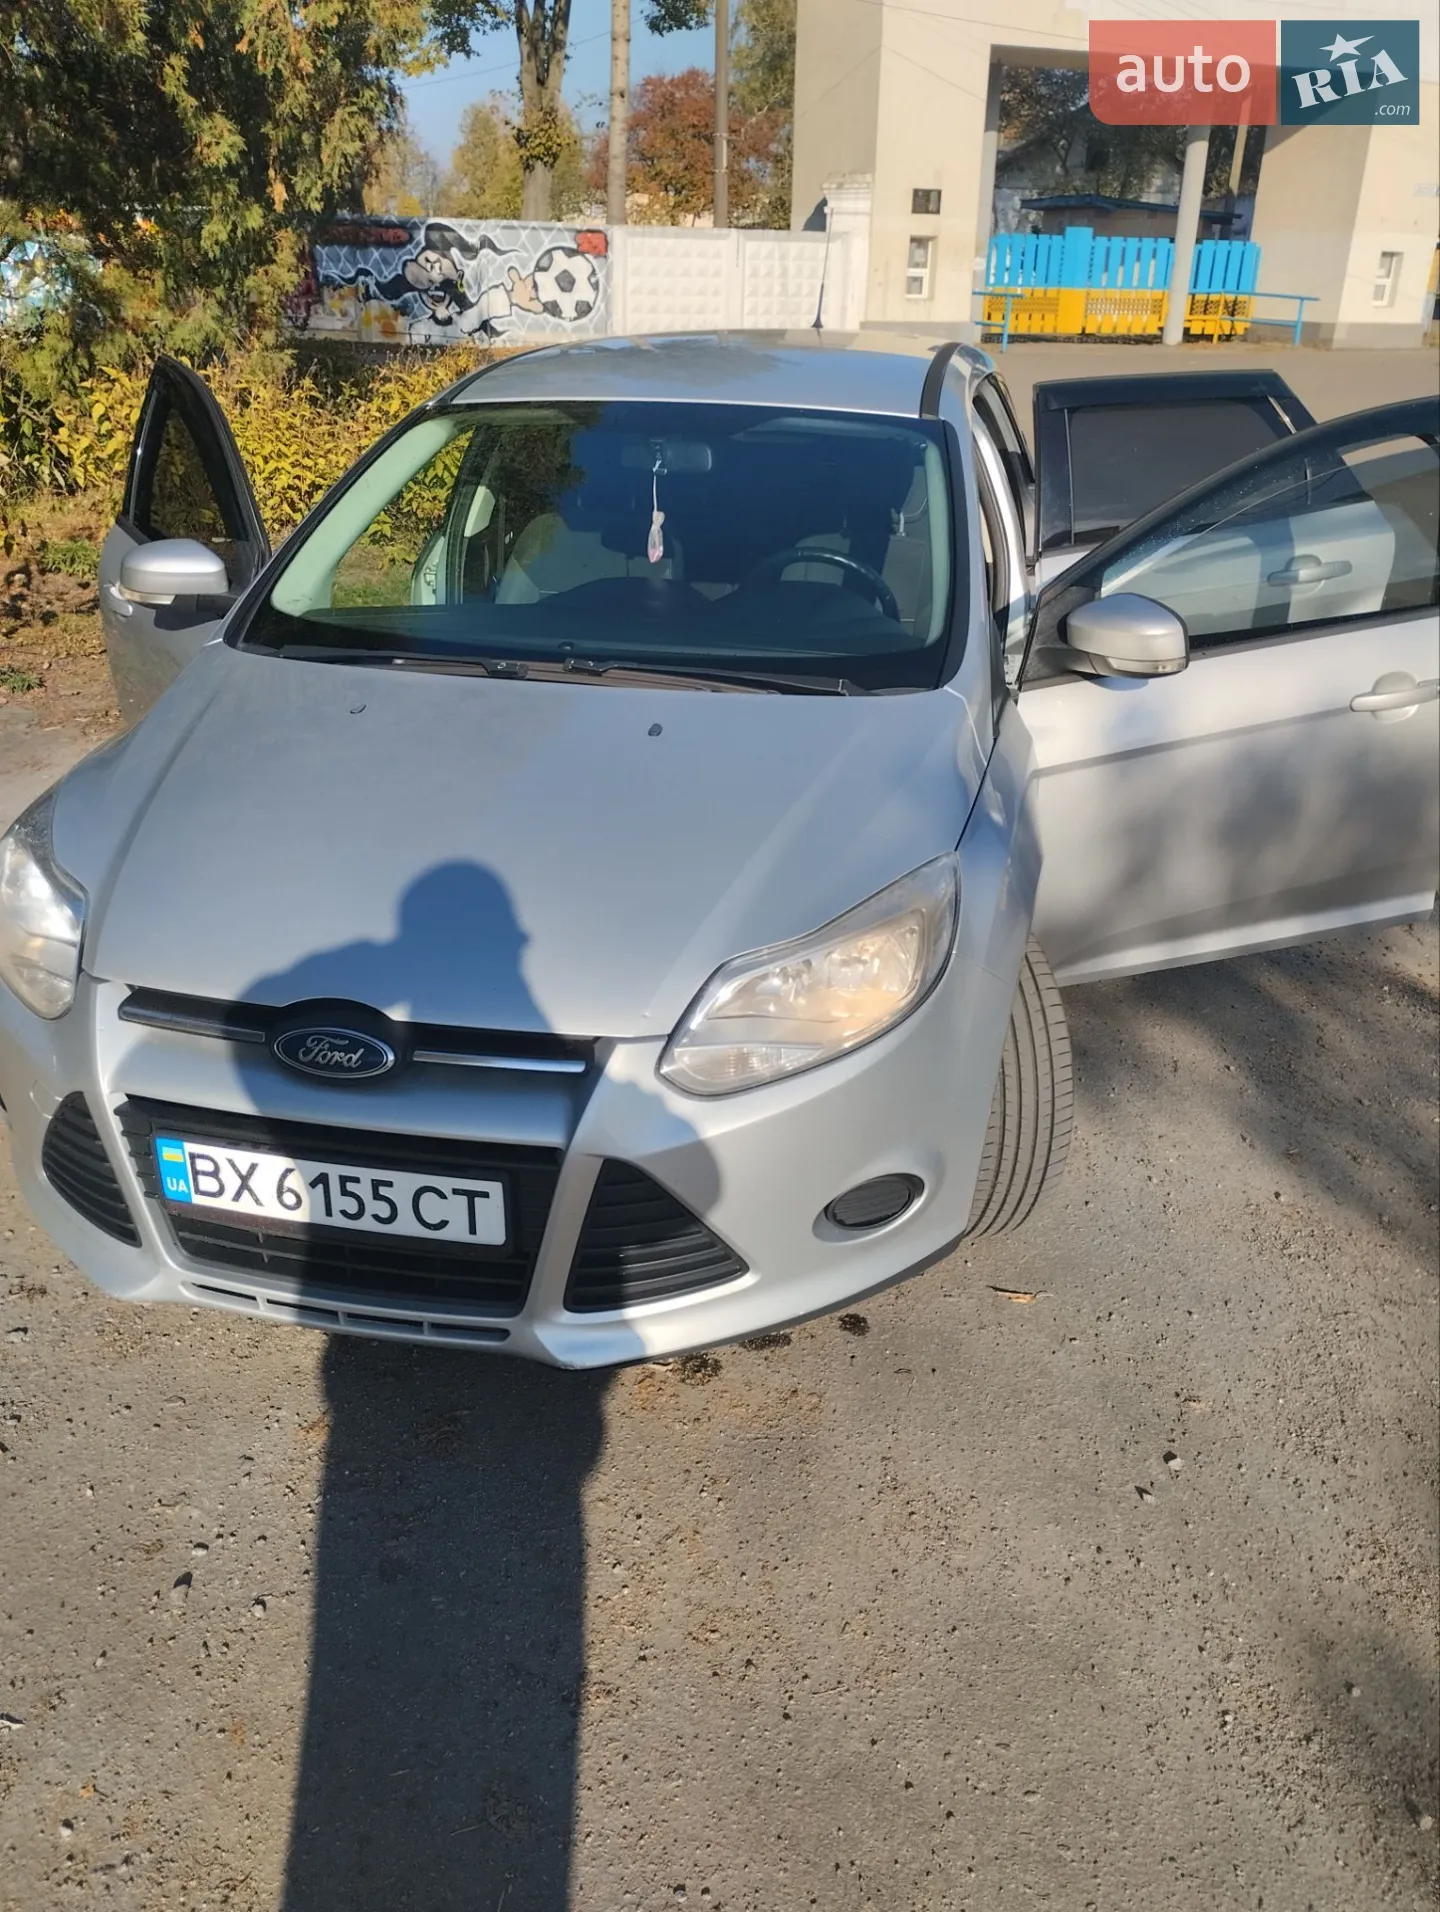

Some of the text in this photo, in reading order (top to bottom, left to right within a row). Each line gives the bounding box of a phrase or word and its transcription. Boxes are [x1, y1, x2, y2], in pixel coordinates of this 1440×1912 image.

[298, 1035, 365, 1069] Ford
[166, 1176, 189, 1194] UA
[276, 1168, 398, 1225] 6155
[412, 1185, 490, 1236] CT
